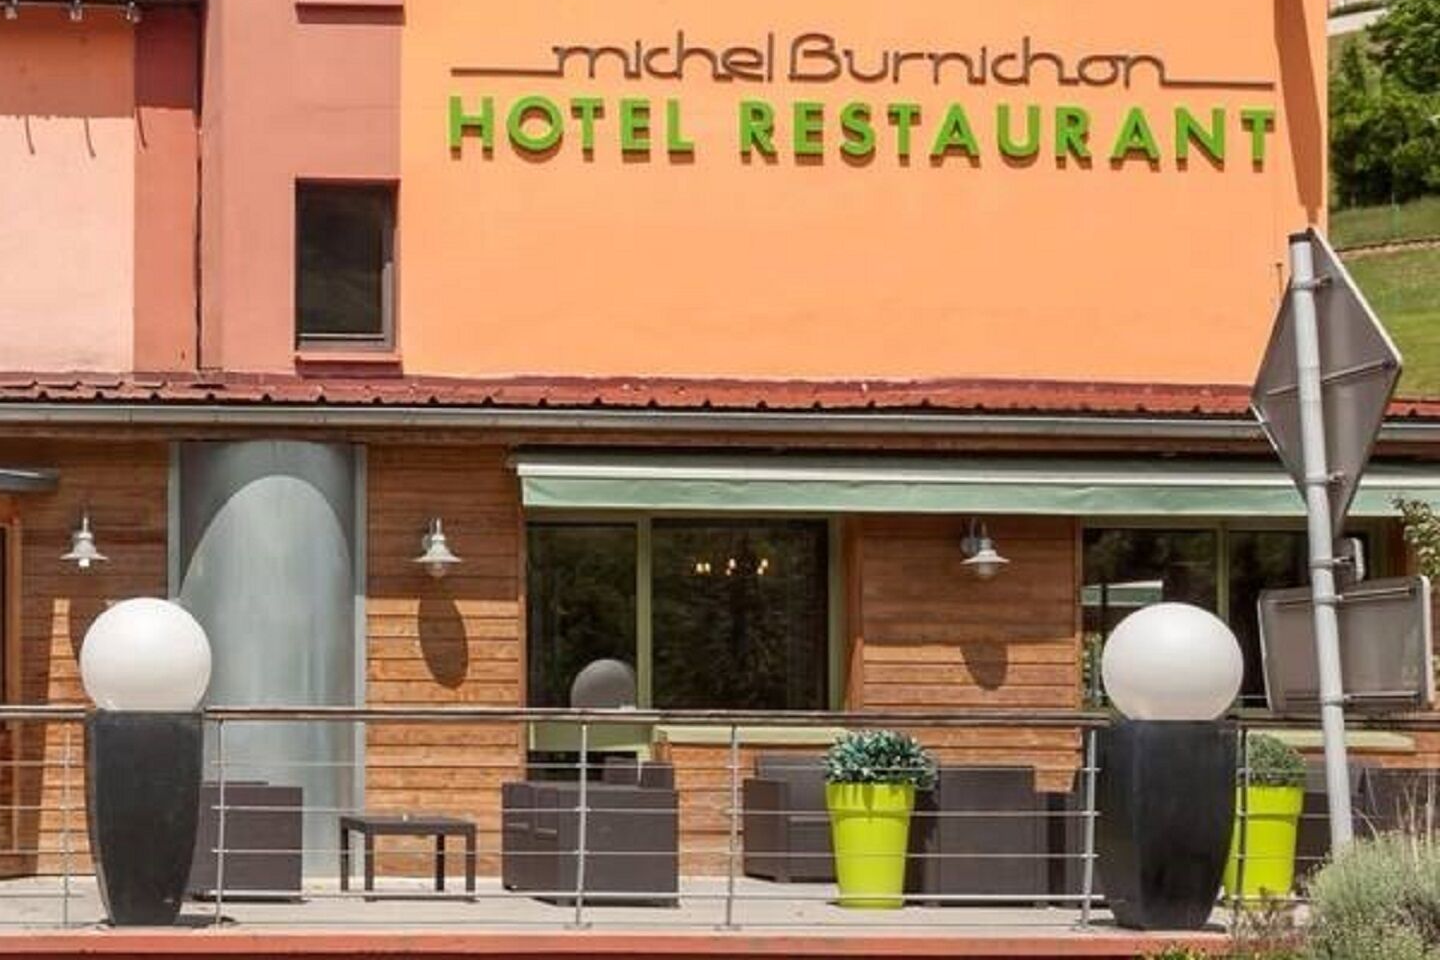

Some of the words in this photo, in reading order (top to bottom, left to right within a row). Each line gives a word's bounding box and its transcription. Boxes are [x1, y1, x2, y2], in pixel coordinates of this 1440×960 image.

[551, 29, 773, 82] michel
[788, 32, 1166, 89] Burnichon
[449, 95, 695, 156] HOTEL
[739, 100, 1275, 167] RESTAURANT
